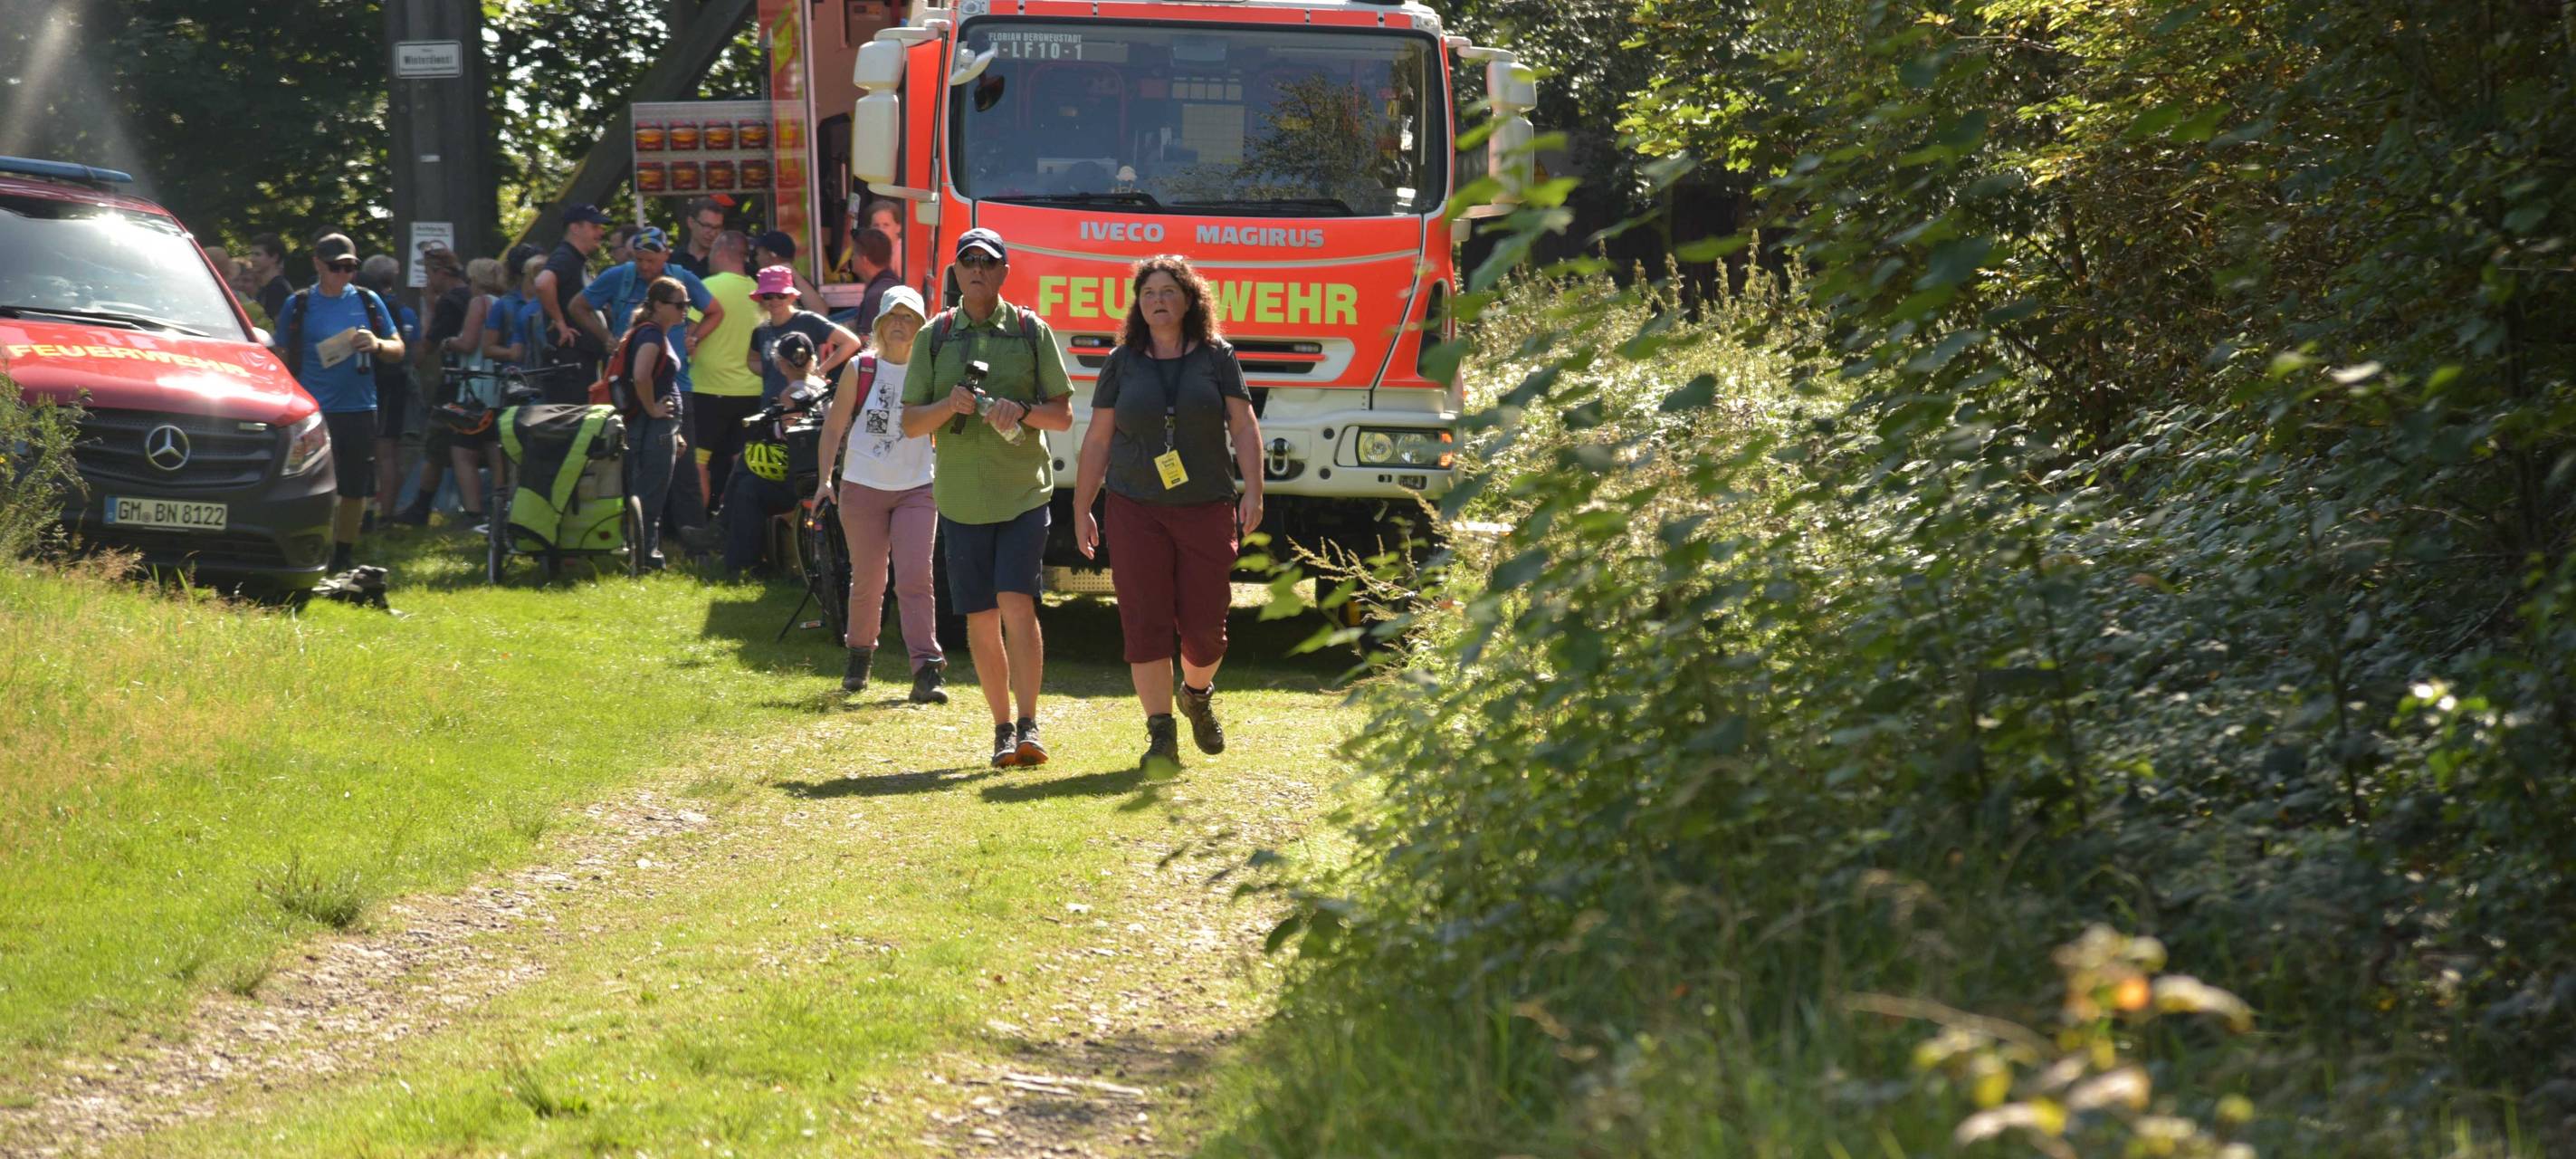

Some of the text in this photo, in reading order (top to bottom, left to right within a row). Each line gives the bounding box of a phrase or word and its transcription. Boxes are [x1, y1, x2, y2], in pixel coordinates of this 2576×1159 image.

[1080, 221, 1324, 248] IVECO MAGIRUS
[1039, 275, 1358, 324] FEUWEHR
[7, 344, 252, 378] FEUERWEHR
[119, 501, 225, 525] GM BN 8122
